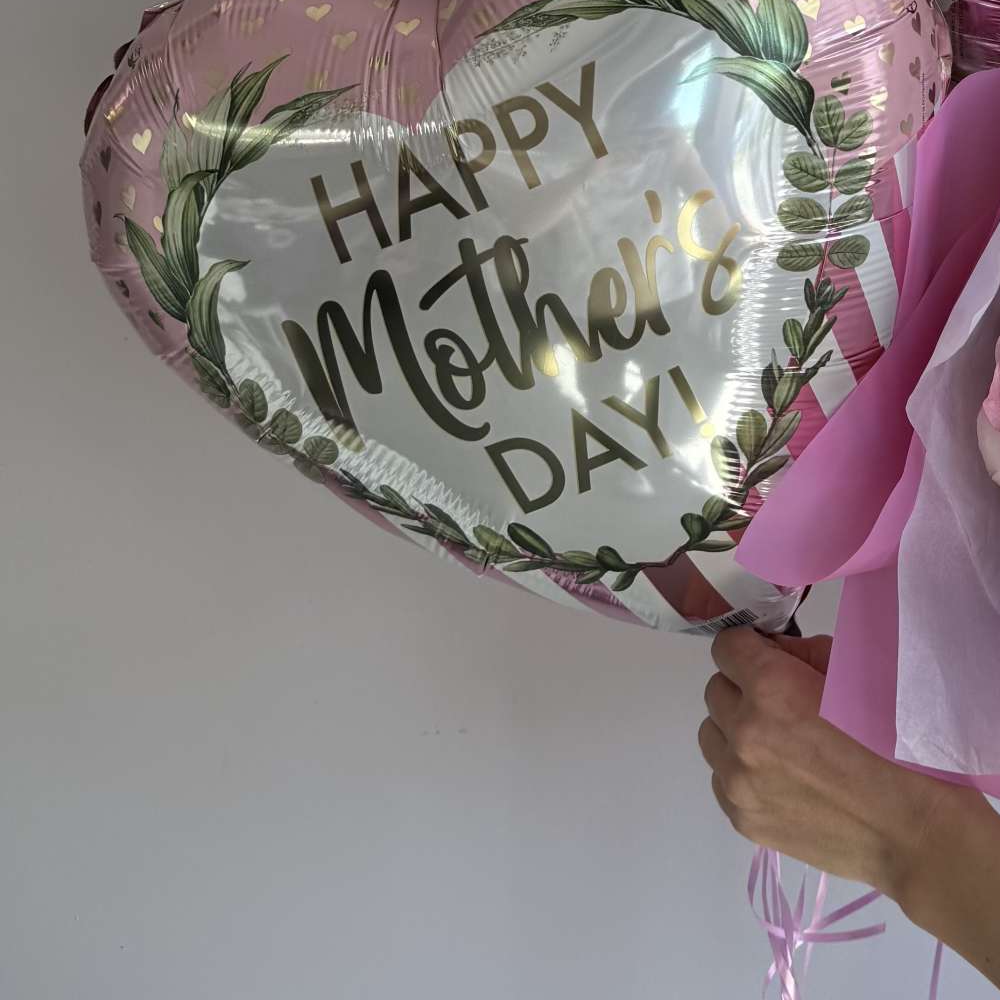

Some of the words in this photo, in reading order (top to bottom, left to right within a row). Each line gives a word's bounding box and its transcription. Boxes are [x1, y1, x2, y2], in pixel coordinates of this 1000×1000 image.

[310, 60, 609, 264] HAPPY
[281, 189, 742, 453] Mother's
[484, 365, 717, 515] DAY!
